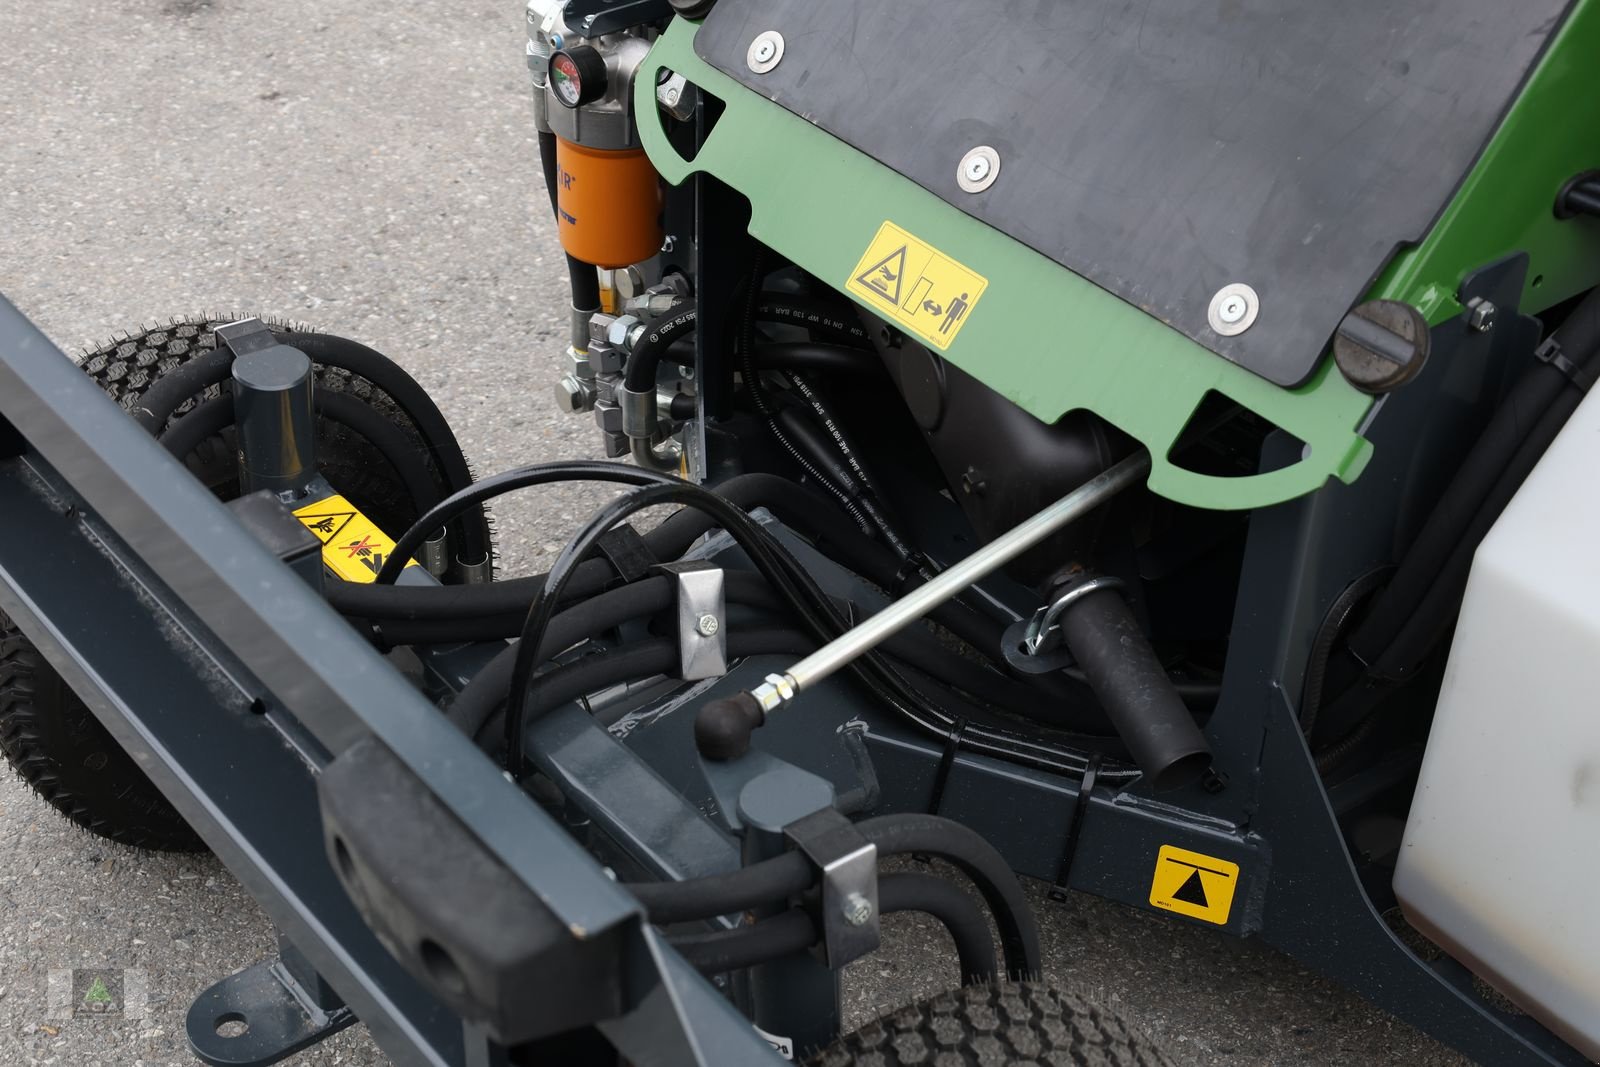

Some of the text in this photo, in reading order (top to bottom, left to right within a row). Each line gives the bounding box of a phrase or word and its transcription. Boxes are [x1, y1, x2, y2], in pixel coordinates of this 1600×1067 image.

[832, 430, 842, 442] 100
[839, 441, 850, 454] SAE
[849, 457, 860, 472] BAR
